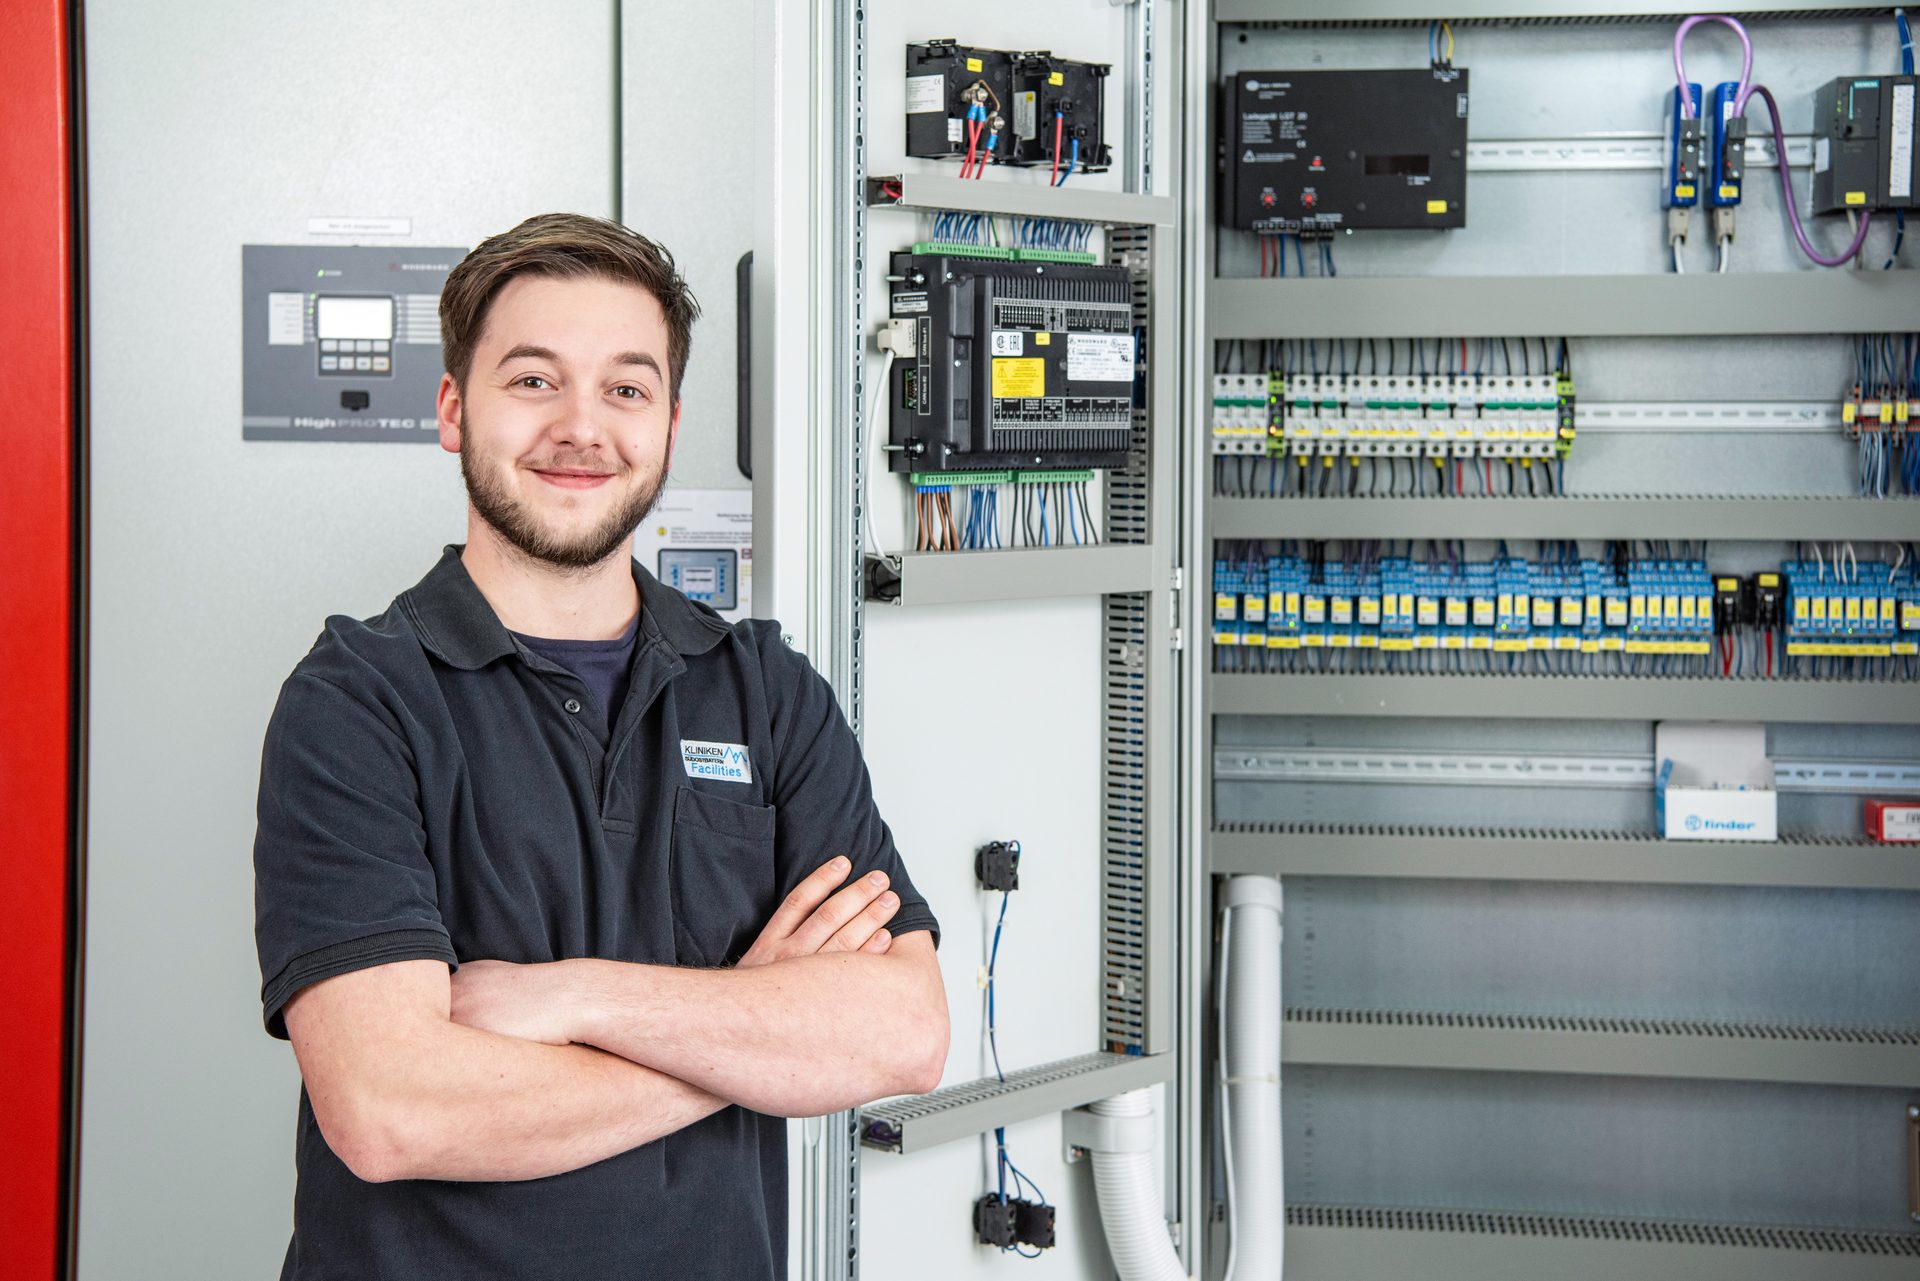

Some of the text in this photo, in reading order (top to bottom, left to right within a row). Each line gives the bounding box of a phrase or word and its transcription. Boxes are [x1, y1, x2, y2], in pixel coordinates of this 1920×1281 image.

[684, 745, 723, 756] KLINIKEN
[691, 762, 742, 777] Facilities
[1704, 820, 1756, 830] finder
